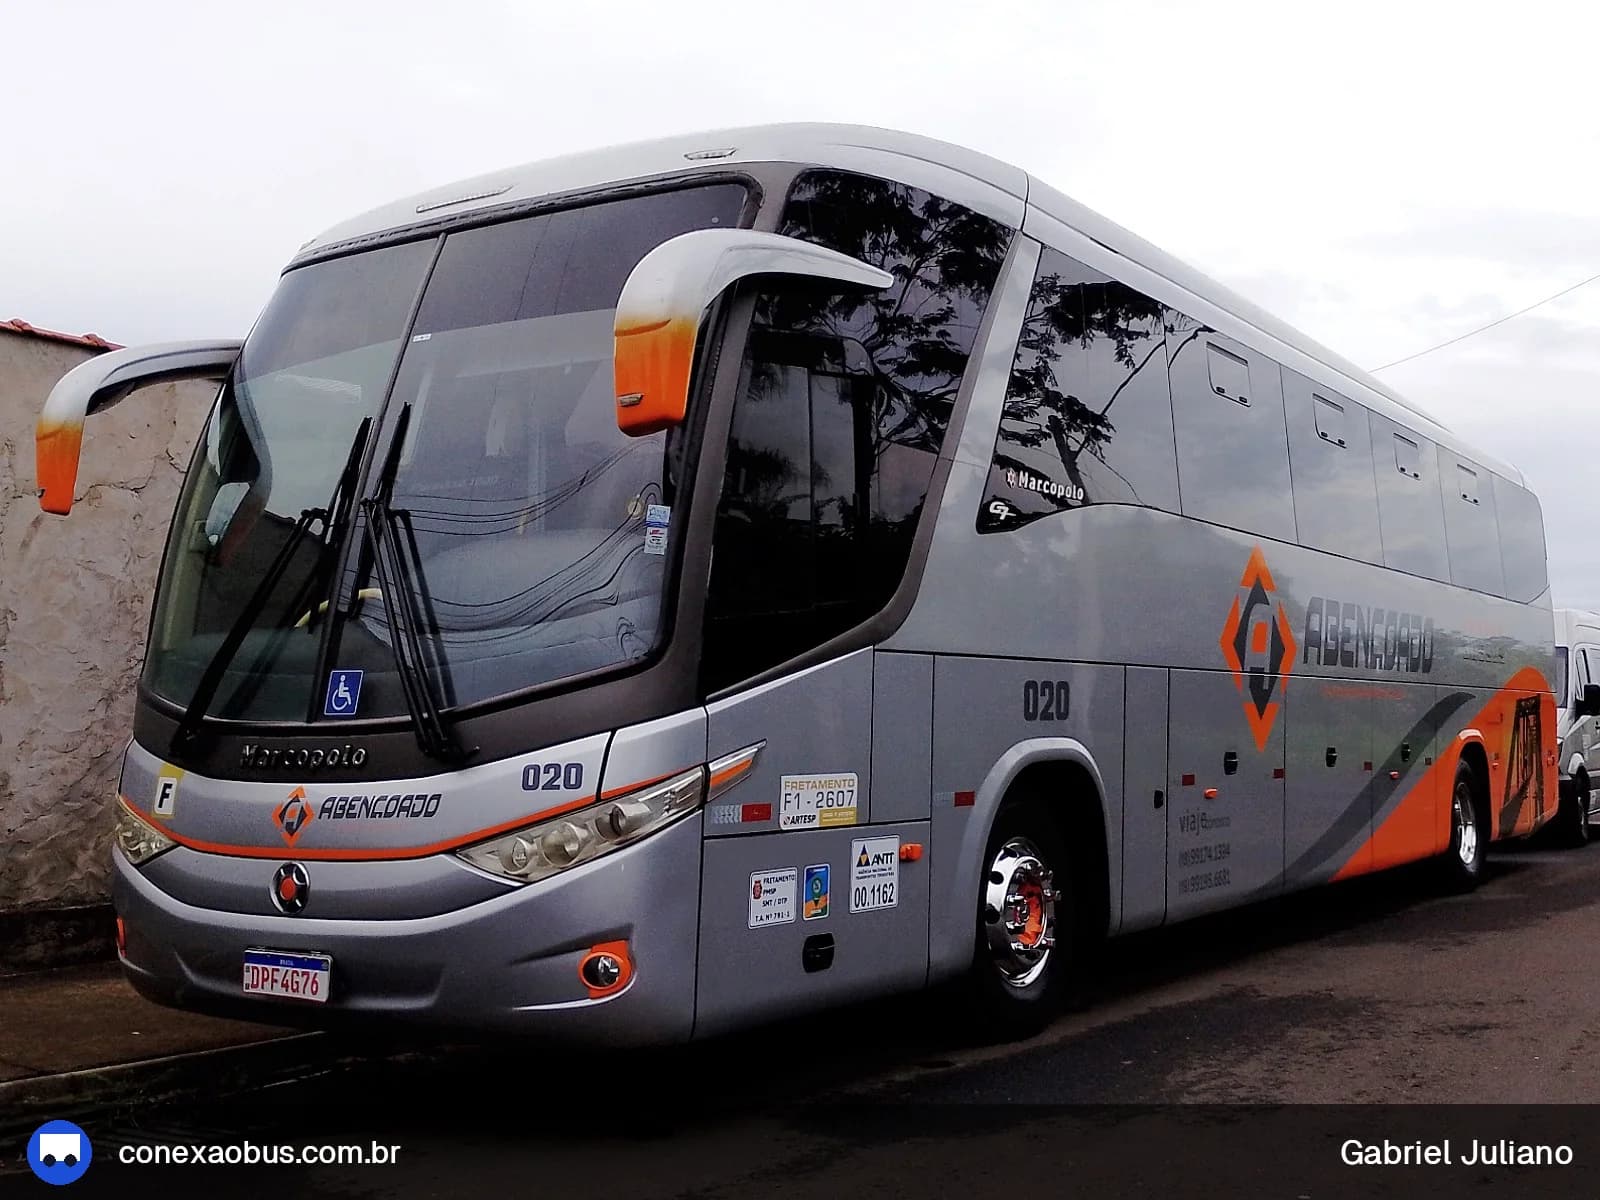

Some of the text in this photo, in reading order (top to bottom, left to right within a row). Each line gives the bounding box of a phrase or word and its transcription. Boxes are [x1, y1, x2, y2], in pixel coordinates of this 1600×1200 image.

[1017, 470, 1085, 501] Marcopolo
[1023, 680, 1070, 721] 020
[240, 744, 368, 769] Marcopolo
[522, 762, 584, 792] 020
[784, 778, 856, 791] FRETAMENTO
[157, 782, 174, 809] F
[789, 814, 817, 825] ARTESP
[871, 852, 894, 866] ANTT
[854, 882, 895, 909] 00.1162
[250, 965, 319, 996] DPF4G76
